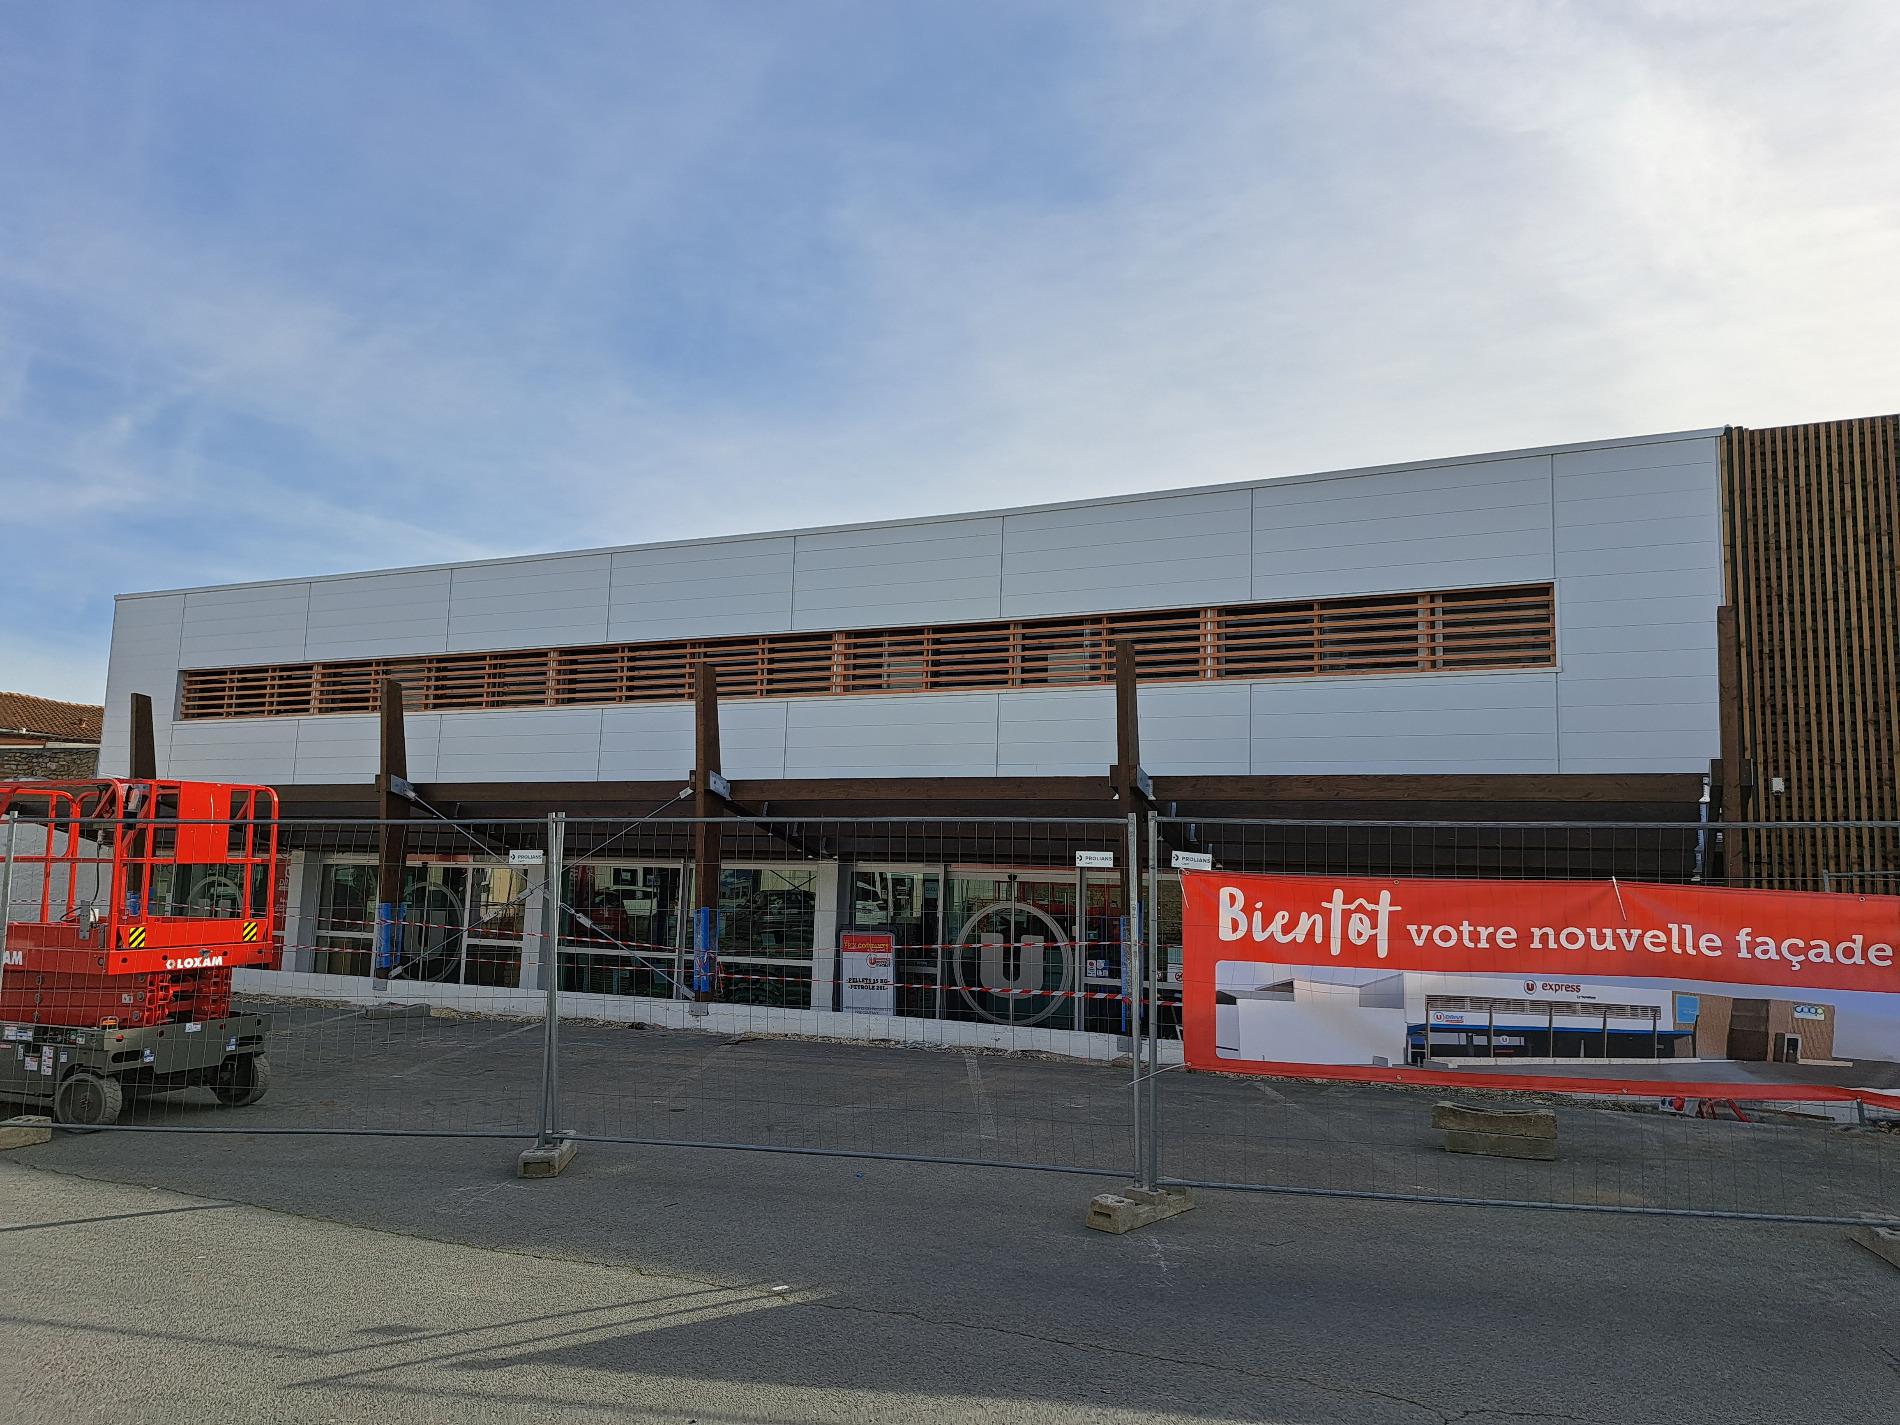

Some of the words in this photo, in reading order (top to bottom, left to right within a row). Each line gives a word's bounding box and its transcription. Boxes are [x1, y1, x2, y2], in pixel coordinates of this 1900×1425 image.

[1181, 856, 1211, 864] PROLIANS
[1218, 886, 1402, 959] Bientôt
[1407, 920, 1518, 949] votre
[1529, 923, 1722, 956] nouvelle
[1736, 928, 1894, 970] façade
[176, 956, 223, 968] LOXAM
[980, 932, 1045, 1000] U
[1541, 981, 1581, 994] express
